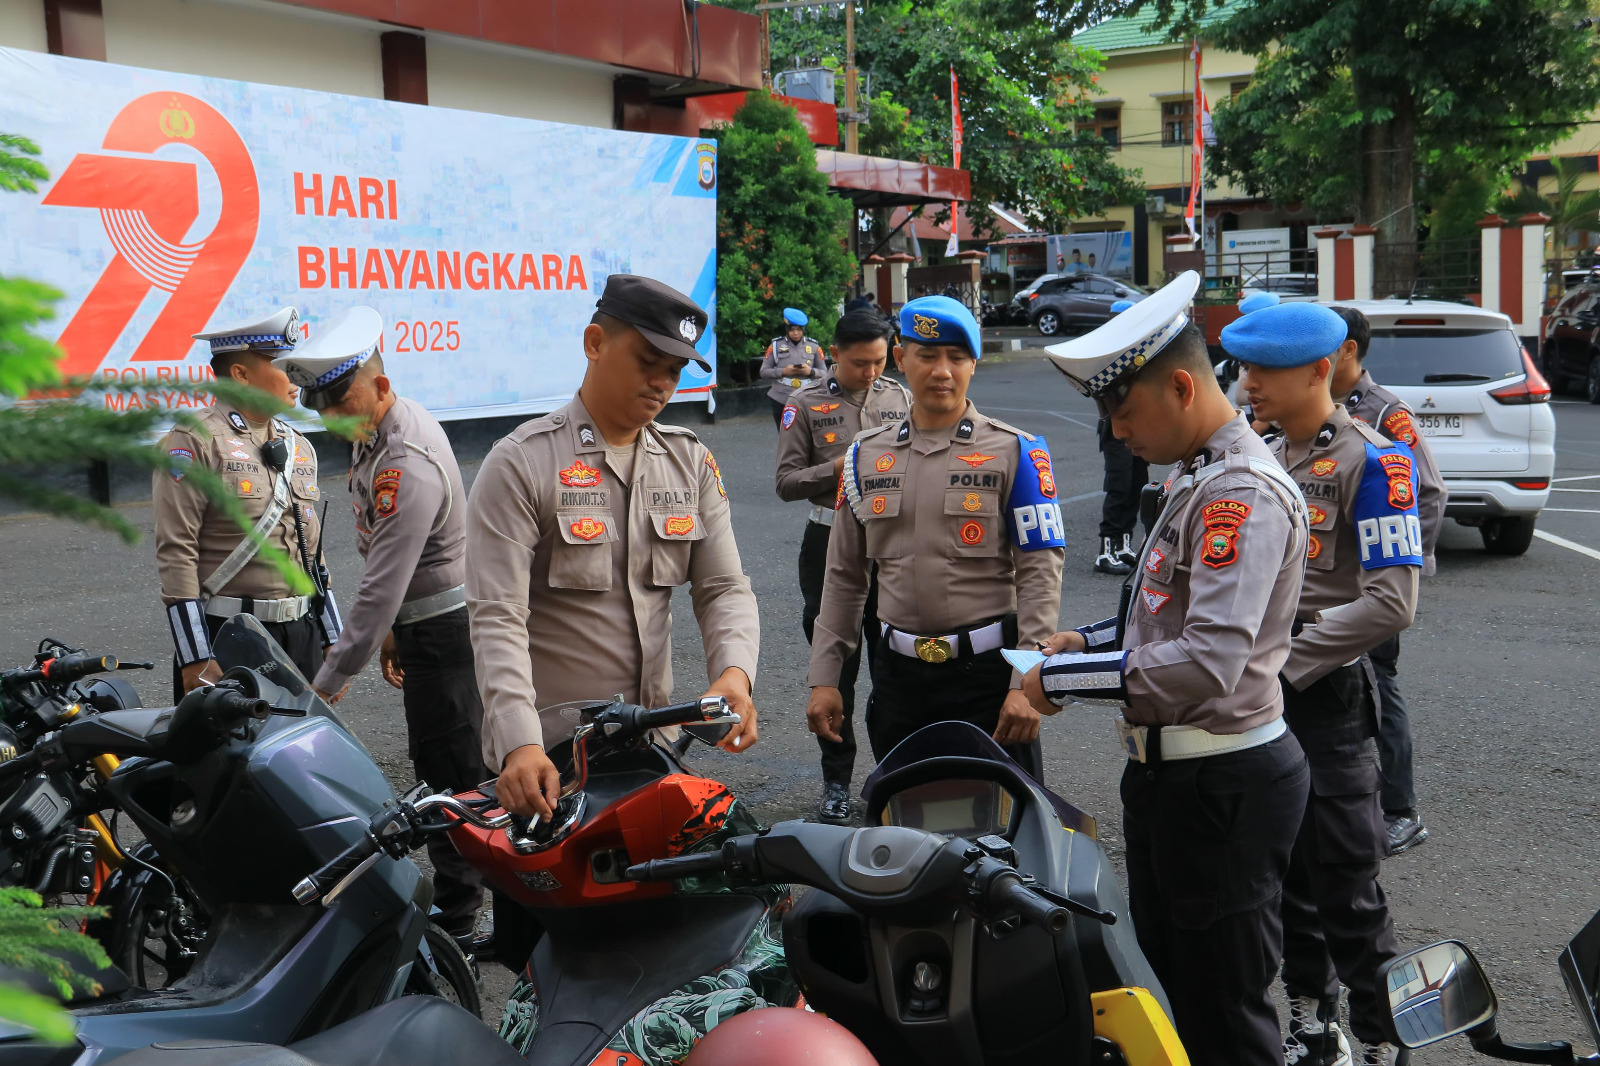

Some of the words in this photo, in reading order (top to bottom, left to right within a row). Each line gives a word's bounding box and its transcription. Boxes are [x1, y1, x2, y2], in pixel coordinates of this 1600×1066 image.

[293, 171, 398, 220] HARI
[298, 246, 588, 290] BHAYANGKARA
[395, 320, 460, 353] 2025
[103, 366, 180, 385] POLRI
[813, 417, 838, 428] PUTRA
[839, 416, 844, 425] P
[1387, 413, 1406, 426] POLDA
[1419, 416, 1440, 428] 356
[1445, 416, 1460, 428] KG
[226, 461, 246, 472] ALEX
[1382, 455, 1410, 465] POLDA
[376, 471, 398, 483] POLDA
[950, 474, 998, 488] POLRI
[1300, 482, 1336, 499] POLRI
[652, 491, 697, 506] POLRI
[1205, 502, 1246, 515] POLDA
